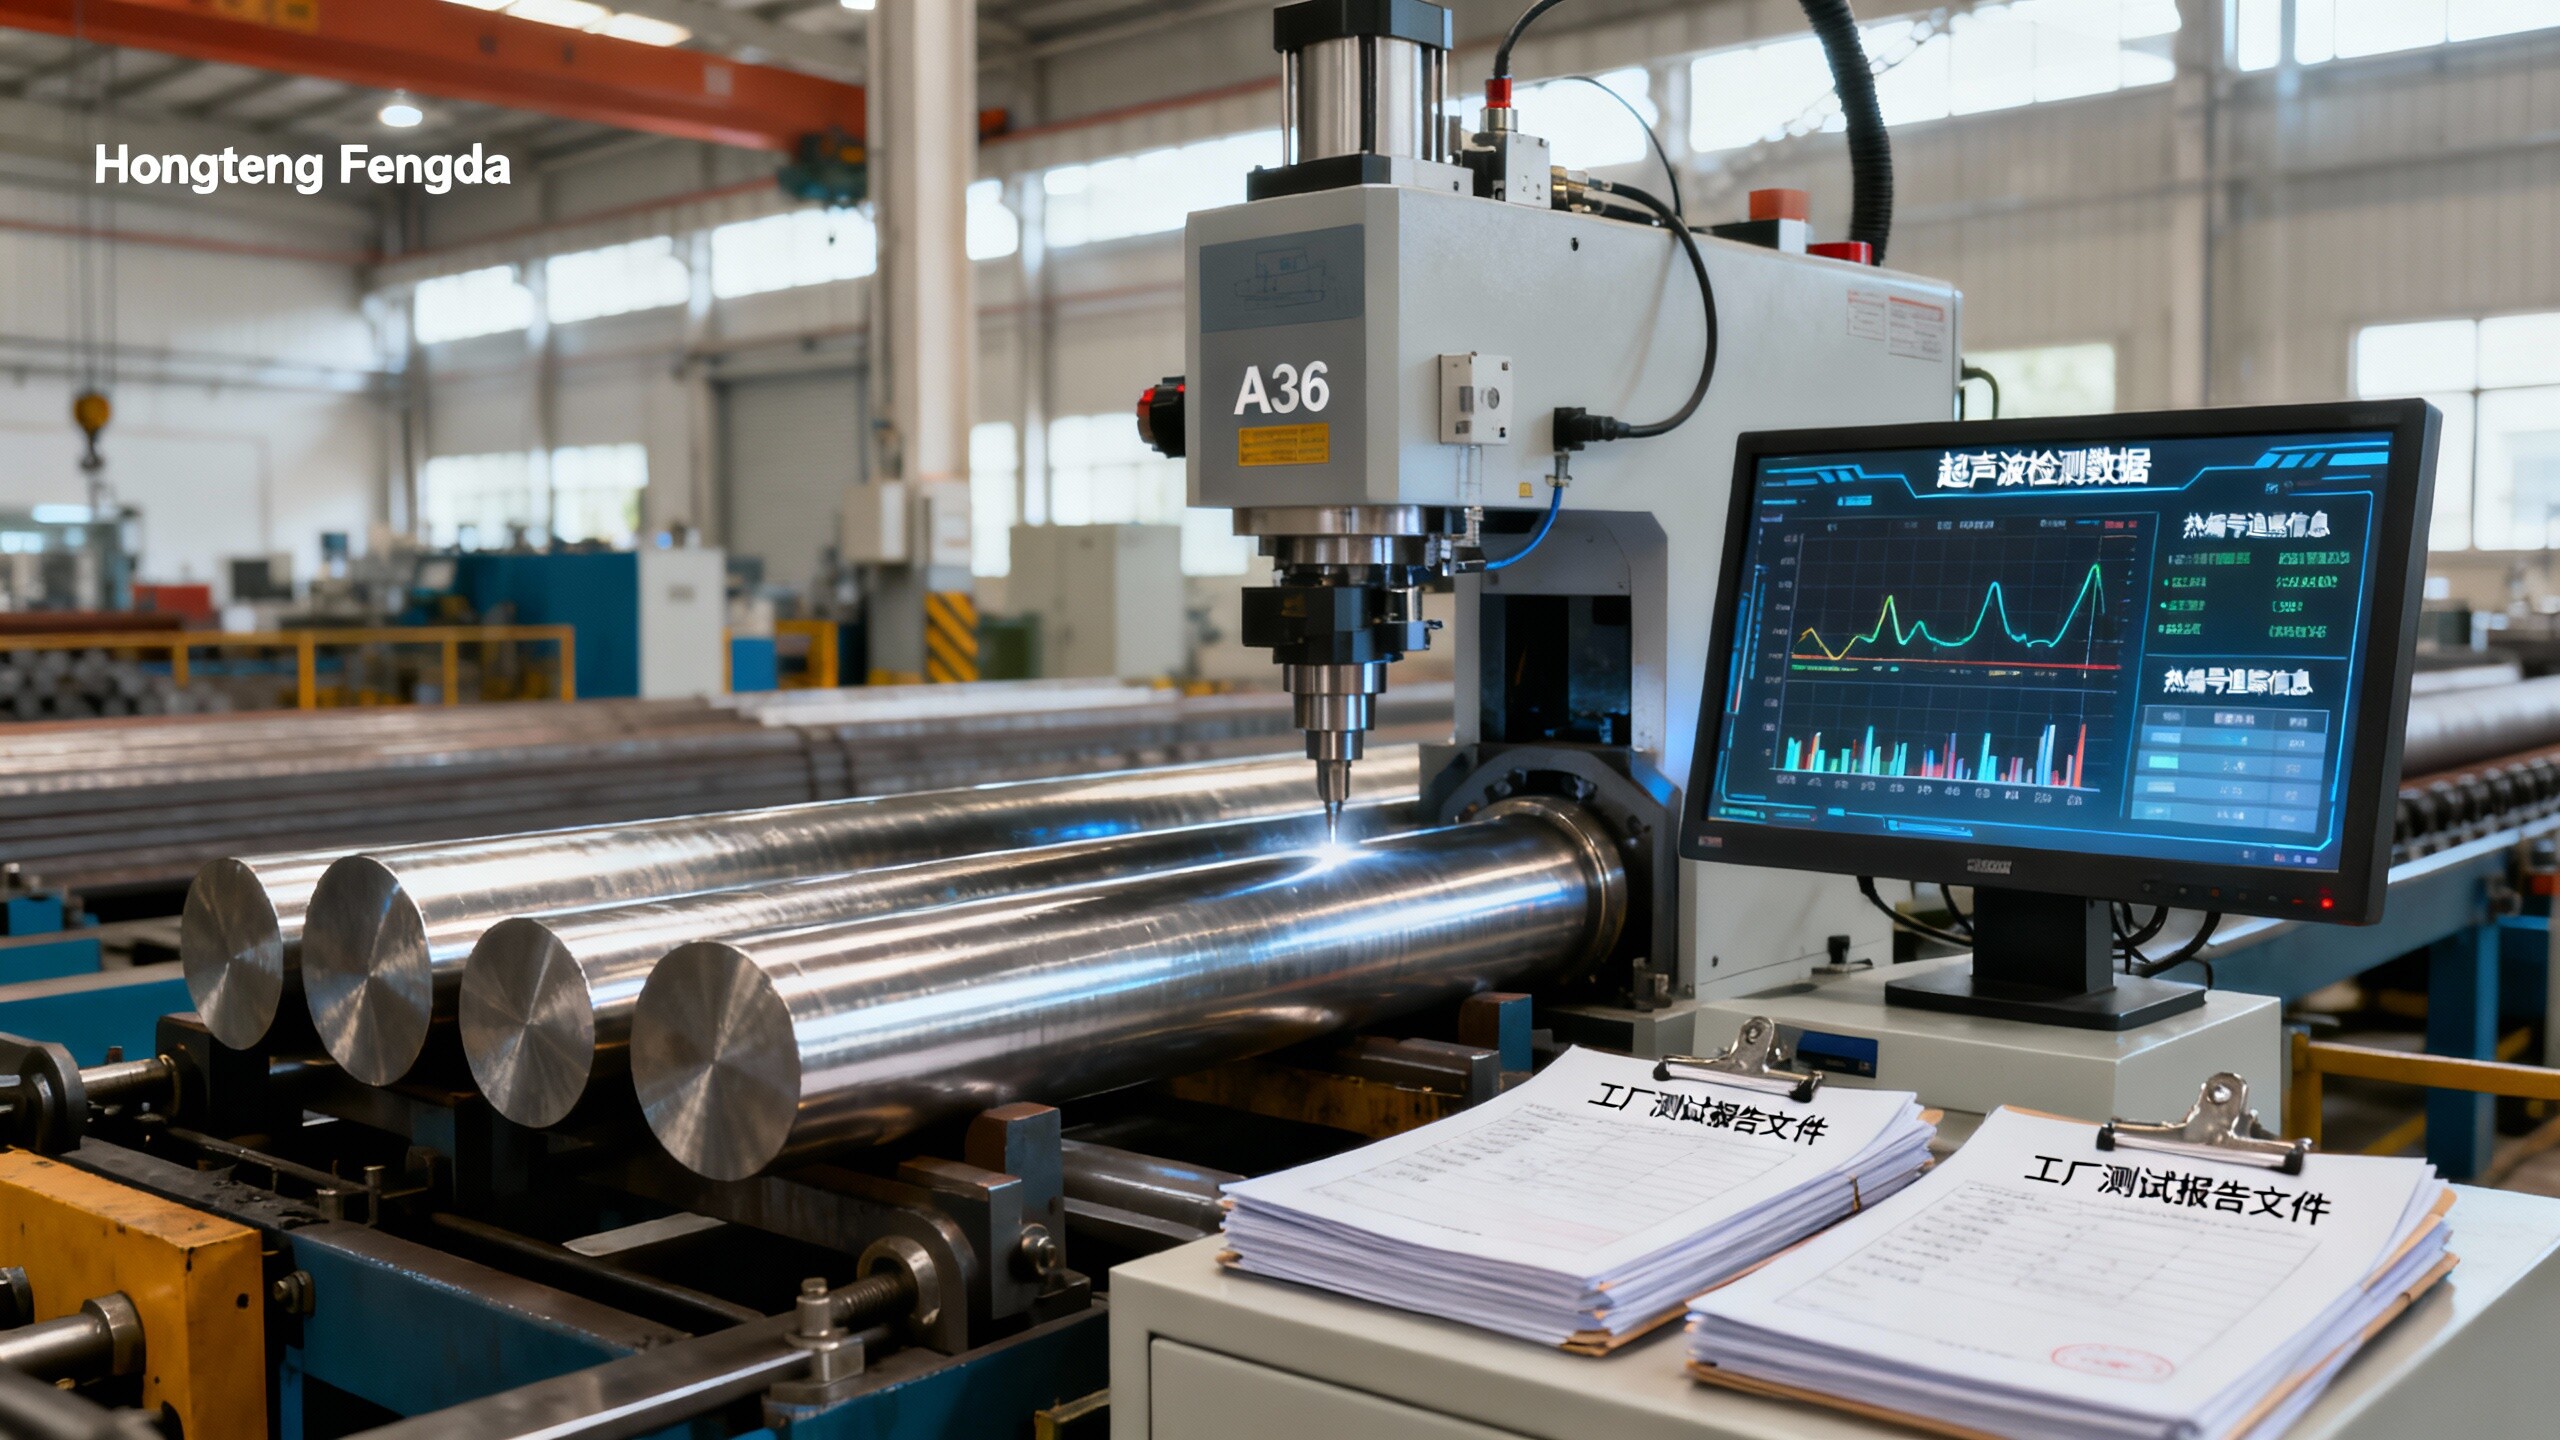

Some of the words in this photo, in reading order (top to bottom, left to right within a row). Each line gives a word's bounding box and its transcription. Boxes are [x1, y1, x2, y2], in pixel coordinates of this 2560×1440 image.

[1234, 361, 1329, 414] A36
[1937, 447, 2152, 488] 超声波检测数据
[2025, 1155, 2331, 1225] 工厂测试报告文件
